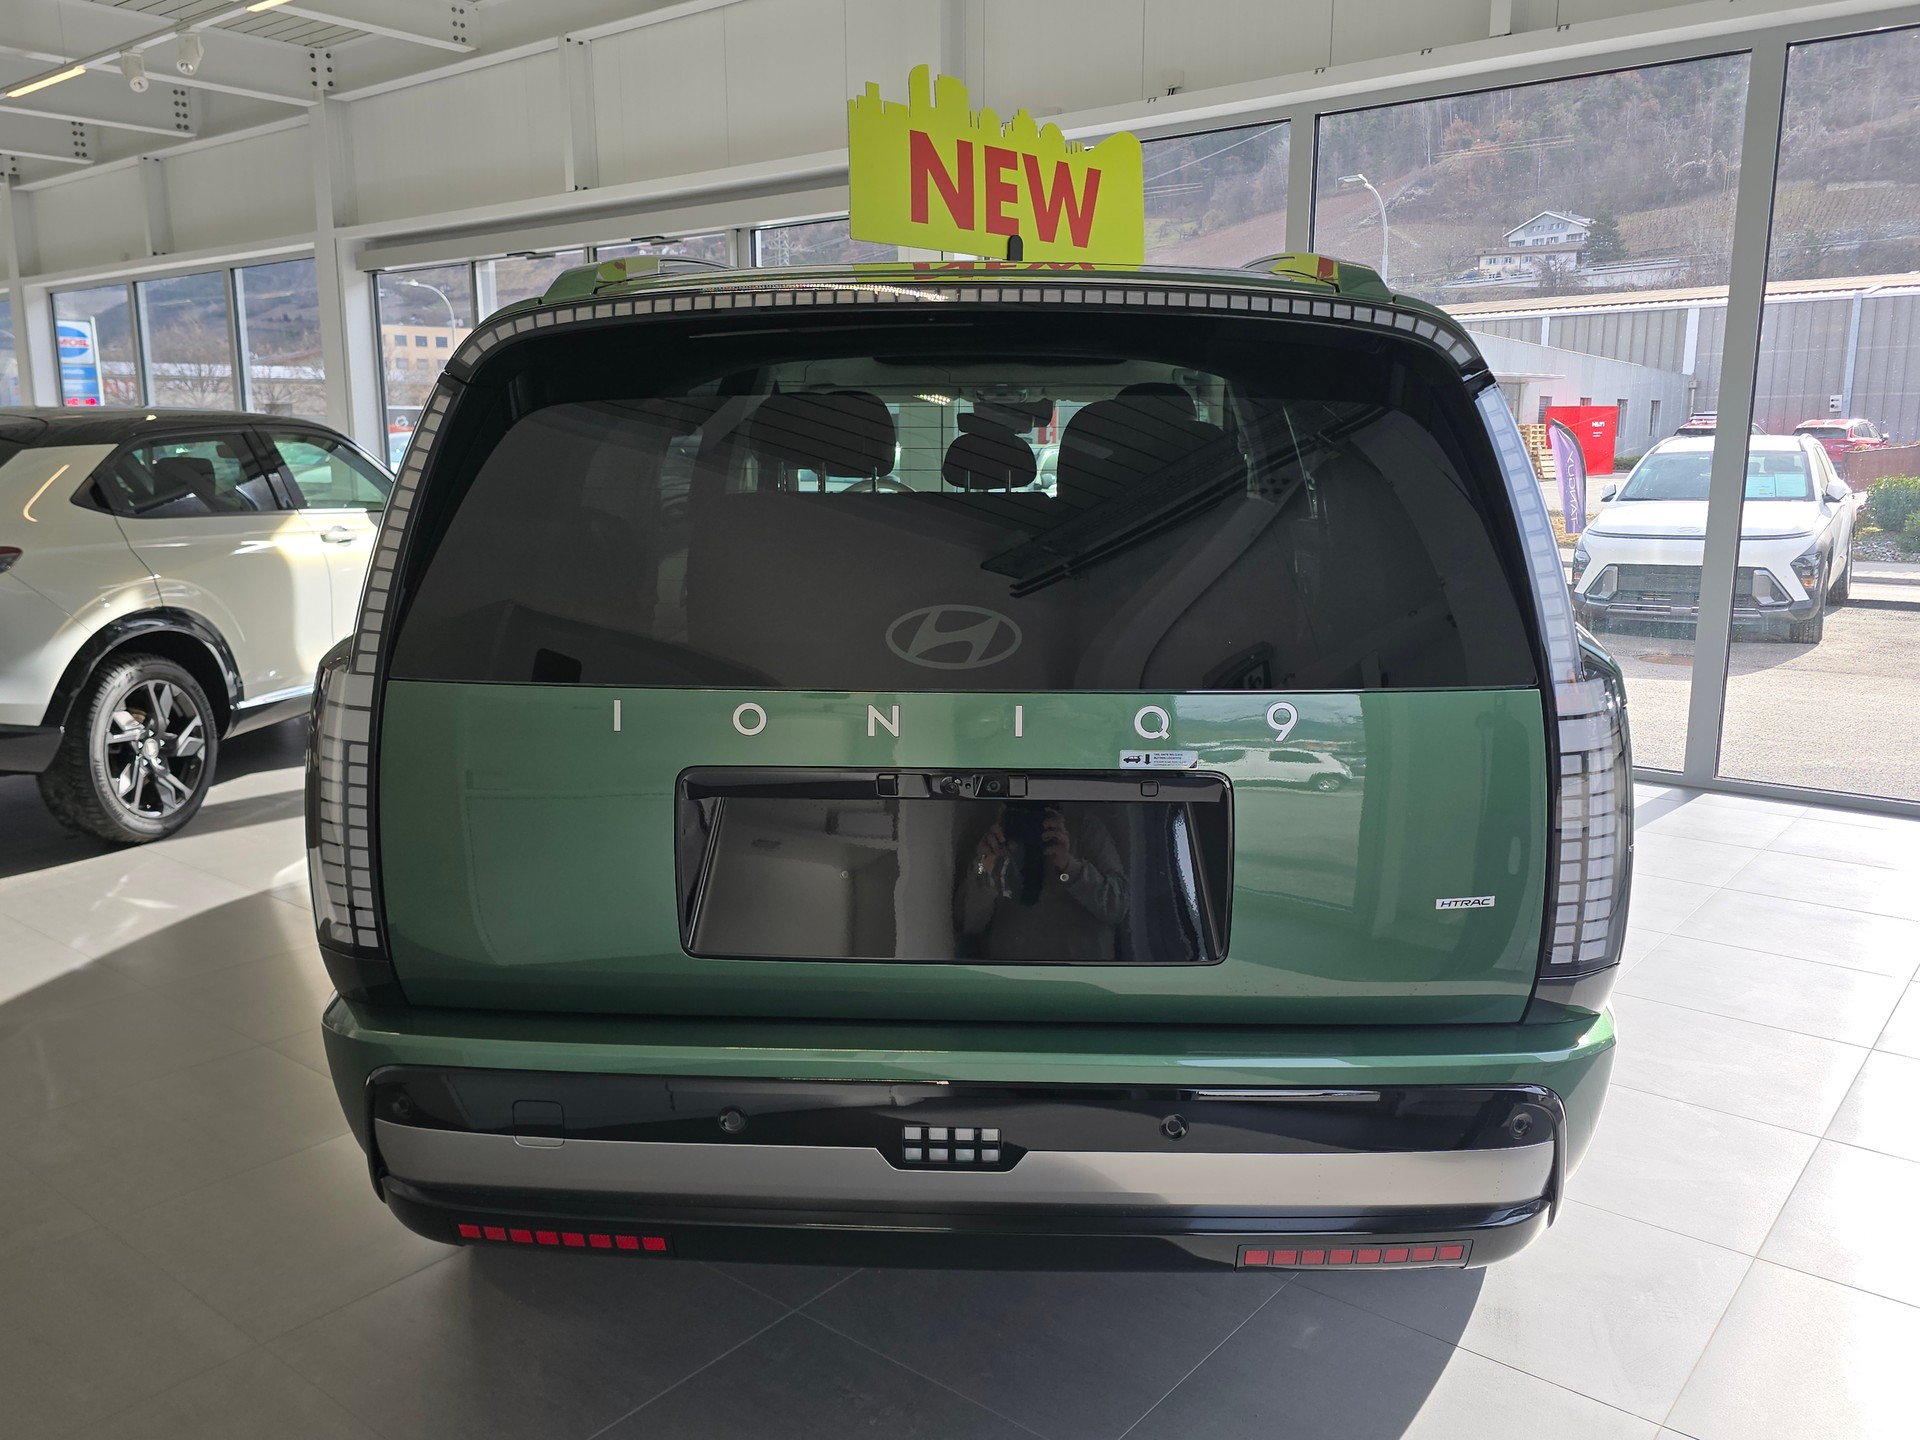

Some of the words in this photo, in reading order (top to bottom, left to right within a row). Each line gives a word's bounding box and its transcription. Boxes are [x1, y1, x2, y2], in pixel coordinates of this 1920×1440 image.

[909, 129, 1102, 248] NEW
[613, 700, 1170, 740] IONIQ
[1265, 702, 1298, 741] 9
[1441, 898, 1491, 907] HTRAC
